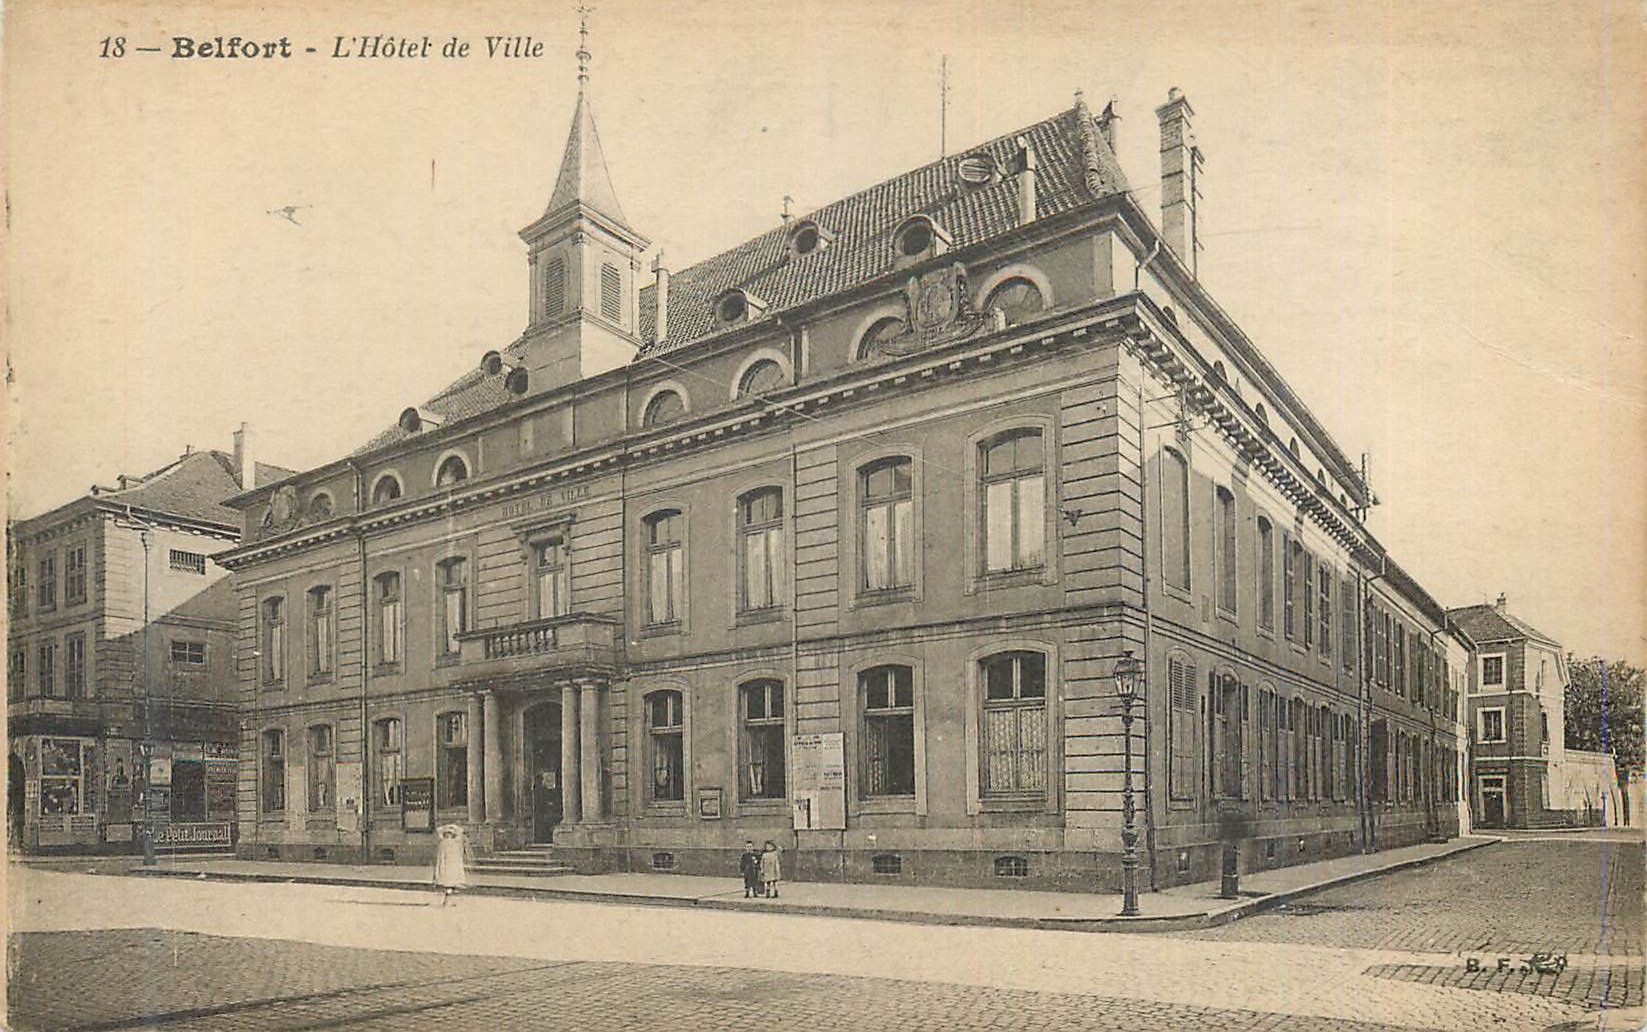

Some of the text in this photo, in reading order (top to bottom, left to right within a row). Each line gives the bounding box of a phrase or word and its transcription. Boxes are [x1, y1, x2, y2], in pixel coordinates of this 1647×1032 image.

[561, 485, 590, 501] VILLE
[152, 825, 229, 843] Le Petit Journal
